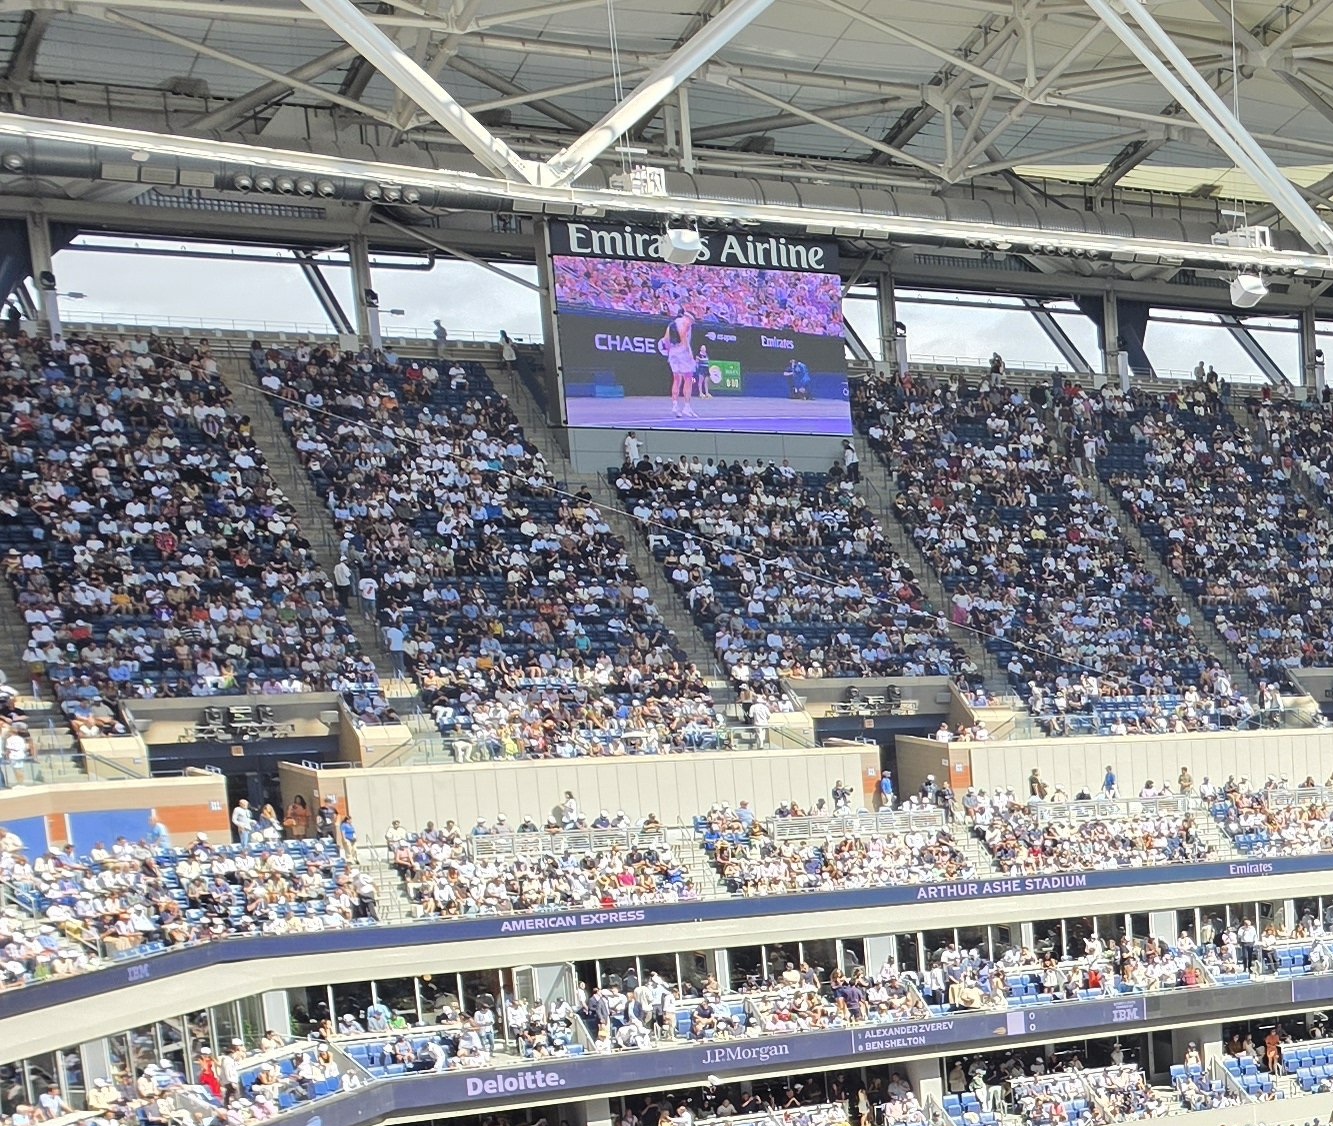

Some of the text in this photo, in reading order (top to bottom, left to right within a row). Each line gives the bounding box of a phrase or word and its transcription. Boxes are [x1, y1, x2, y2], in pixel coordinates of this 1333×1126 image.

[567, 222, 825, 269] Emiras Airline
[594, 333, 657, 354] CHASE
[761, 335, 795, 350] Emirates
[1230, 862, 1273, 876] Emirates
[917, 874, 1087, 900] ARTHUR ASHE STADIUM
[501, 910, 645, 932] AMERICAN EXPRESS
[127, 963, 150, 981] IBM
[1028, 1012, 1035, 1020] 0
[1112, 1008, 1140, 1022] IBM
[864, 1025, 919, 1039] ALEXANDER
[919, 1020, 954, 1033] ZVEREV
[1029, 1023, 1036, 1031] 0
[865, 1040, 884, 1051] BEN
[884, 1035, 926, 1048] SHELTON
[702, 1042, 790, 1064] J.P.Morgan
[466, 1070, 566, 1097] Deloitte.
